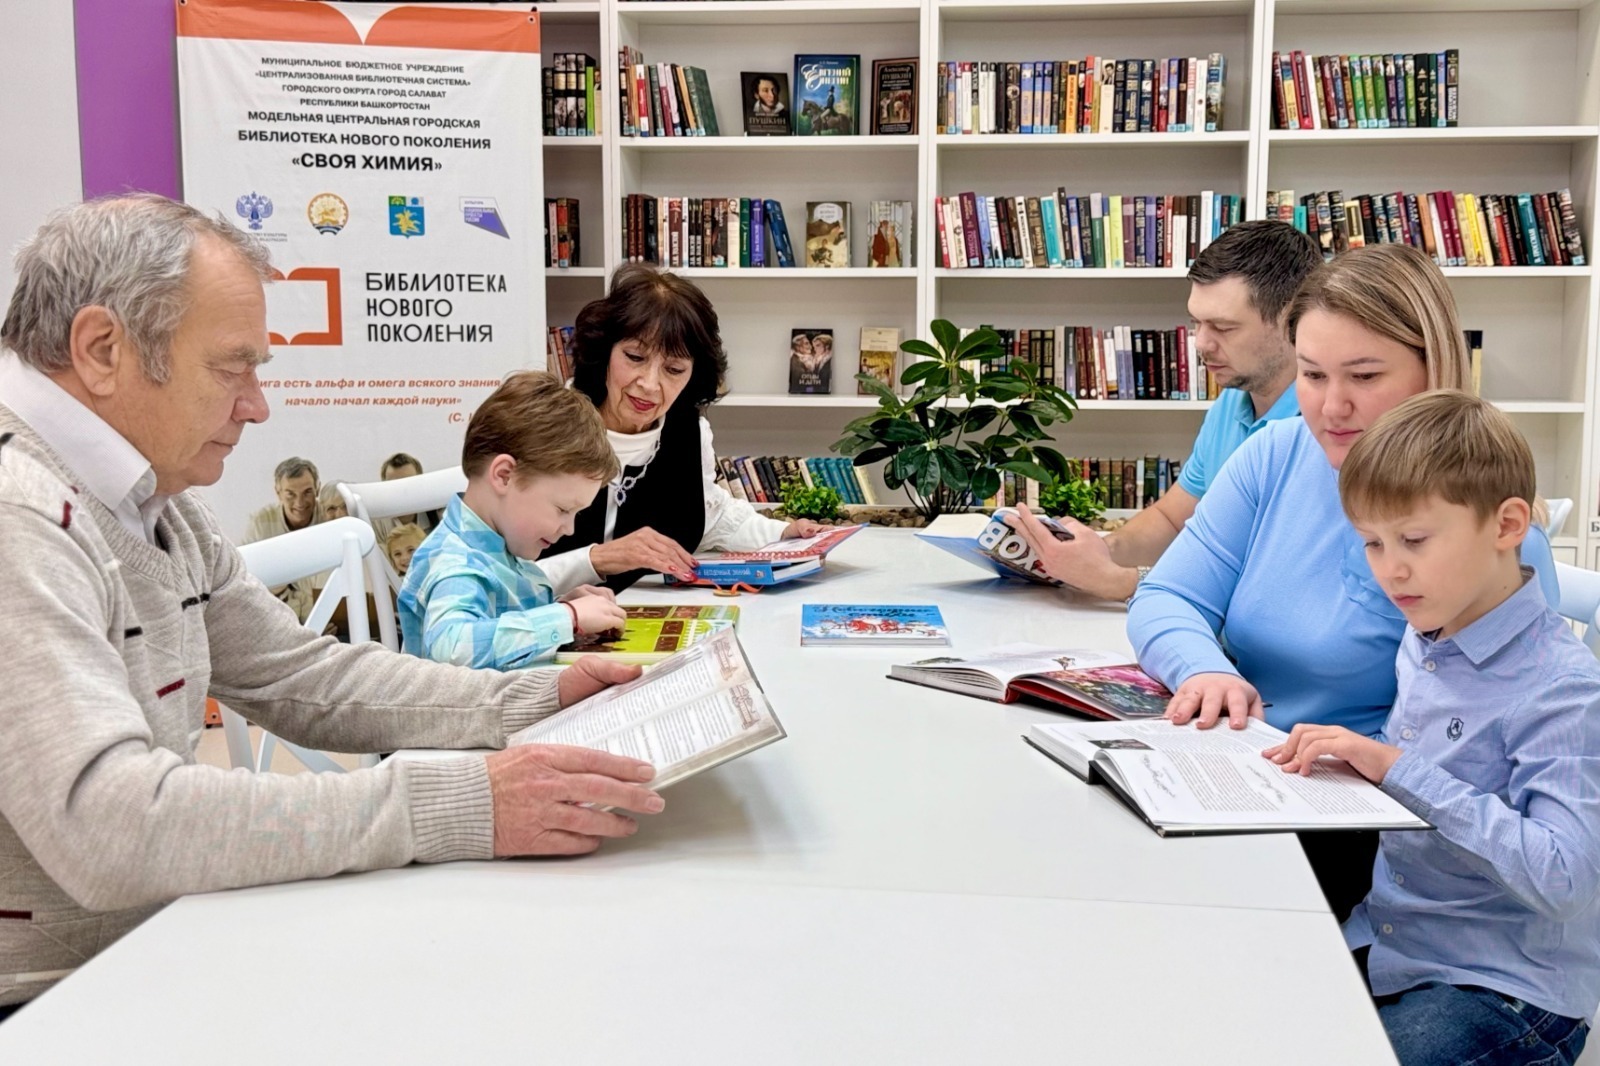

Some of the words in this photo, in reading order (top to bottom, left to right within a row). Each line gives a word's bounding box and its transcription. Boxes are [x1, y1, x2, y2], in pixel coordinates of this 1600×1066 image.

[261, 57, 342, 68] МУНИЦИПАЛЬНОЕ
[345, 61, 402, 71] БЮДЖЕТНОЕ
[406, 64, 464, 73] УЧРЕЖДЕНИЕ
[255, 70, 354, 81] «ЦЕНТРАЛИЗОВАННАЯ
[355, 74, 425, 84] БИБЛИОТЕЧНАЯ
[426, 77, 471, 86] СИСТЕМА»
[282, 84, 341, 94] ГОРОДСКОГО
[343, 87, 376, 95] ОКРУГА
[377, 88, 407, 97] ГОРОД
[408, 90, 447, 98] САЛАВАТ
[299, 98, 359, 107] РЕСПУБЛИКИ
[360, 101, 430, 110] БАШКОРТОСТАН
[248, 111, 323, 123] МОДЕЛЬНАЯ
[326, 114, 410, 126] ЦЕНТРАЛЬНАЯ
[412, 117, 481, 129] ГОРОДСКАЯ
[238, 130, 338, 144] БИБЛИОТЕКА
[340, 134, 400, 146] НОВОГО
[403, 136, 491, 149] ПОКОЛЕНИЯ
[292, 152, 356, 169] «СВОЯ
[361, 155, 442, 171] ХИМИЯ»
[366, 272, 507, 292] БИБЛИОТЕКА
[367, 298, 453, 317] НОВОГО
[368, 324, 493, 342] ПОКОЛЕНИЯ
[260, 380, 281, 388] ига
[284, 380, 312, 388] есть
[315, 378, 354, 389] альфа
[368, 380, 405, 388] омега
[408, 379, 456, 387] всякого
[458, 379, 500, 387] знания
[285, 397, 331, 406] начало
[333, 397, 369, 405] начал
[373, 396, 419, 406] каждой
